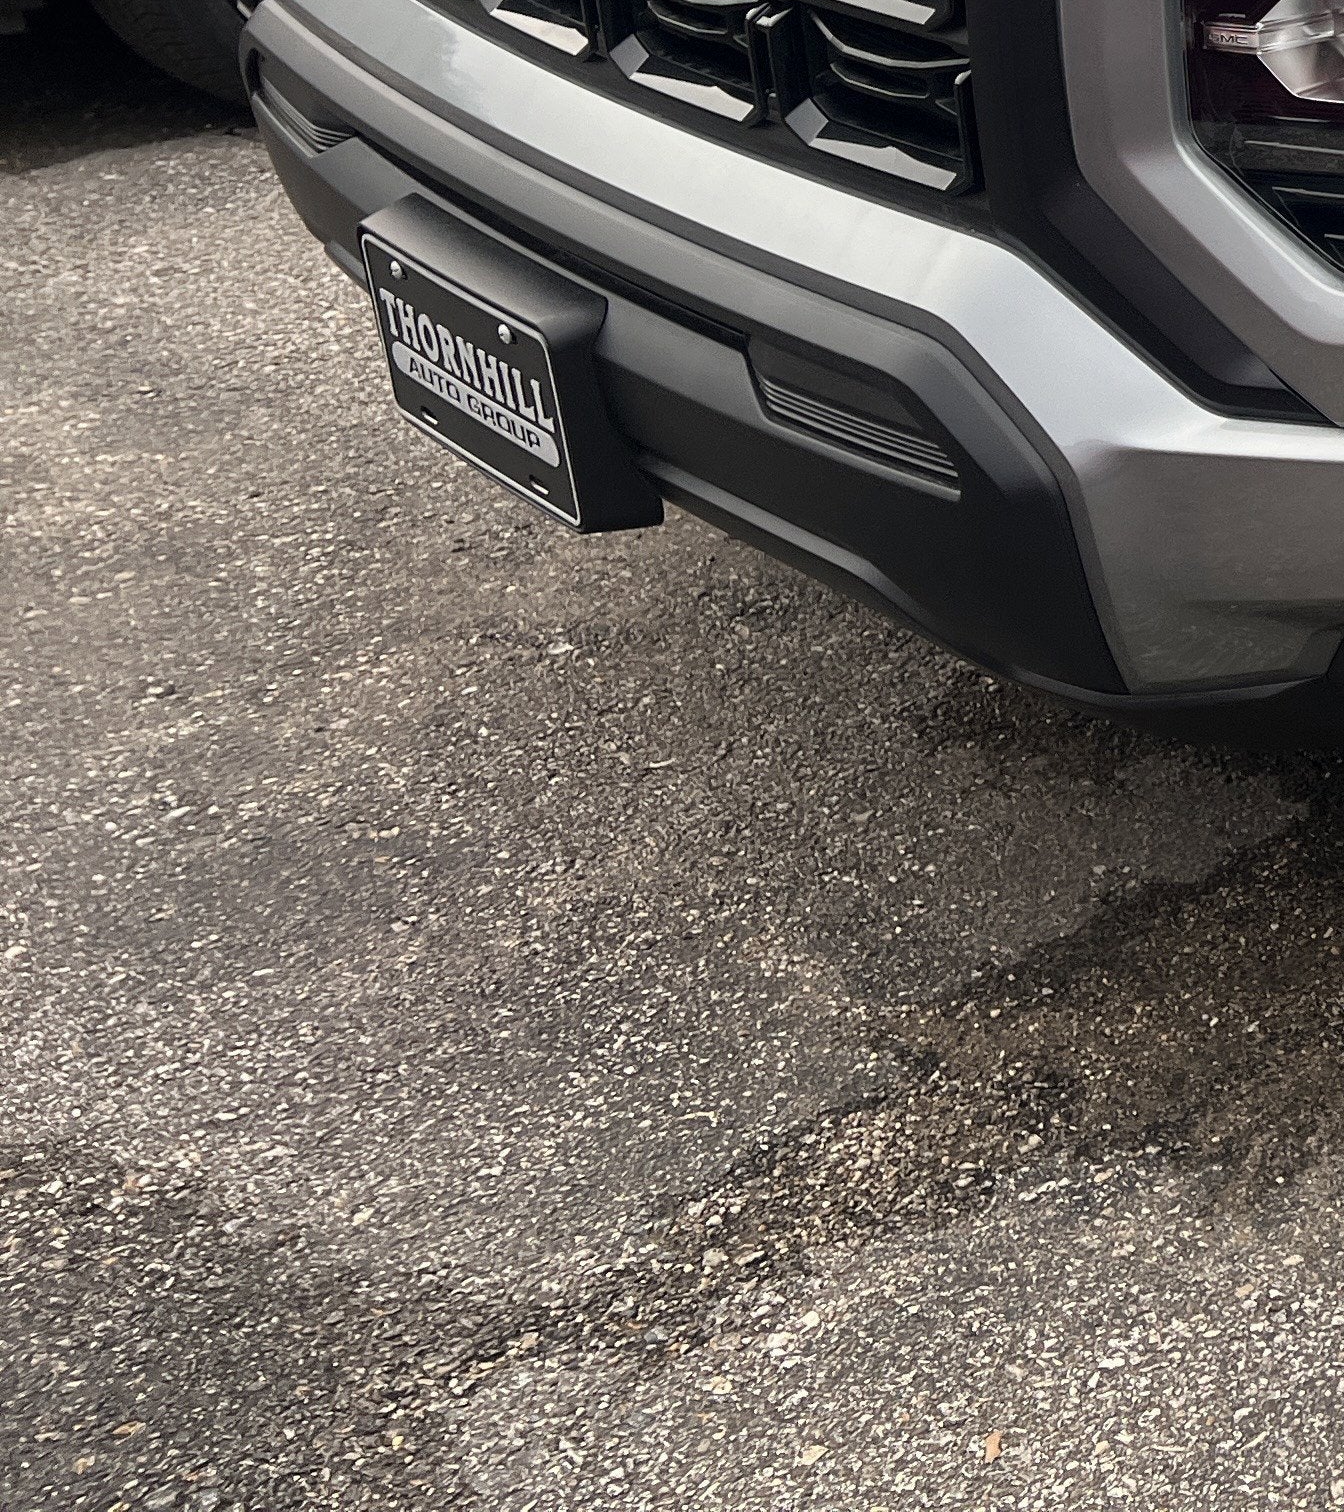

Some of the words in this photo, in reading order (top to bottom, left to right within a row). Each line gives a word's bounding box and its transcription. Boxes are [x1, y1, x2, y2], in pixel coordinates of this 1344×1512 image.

[1208, 33, 1249, 46] GMC
[378, 287, 556, 434] THORNHILL
[408, 355, 461, 405] AUTO
[467, 395, 541, 449] GROUP
